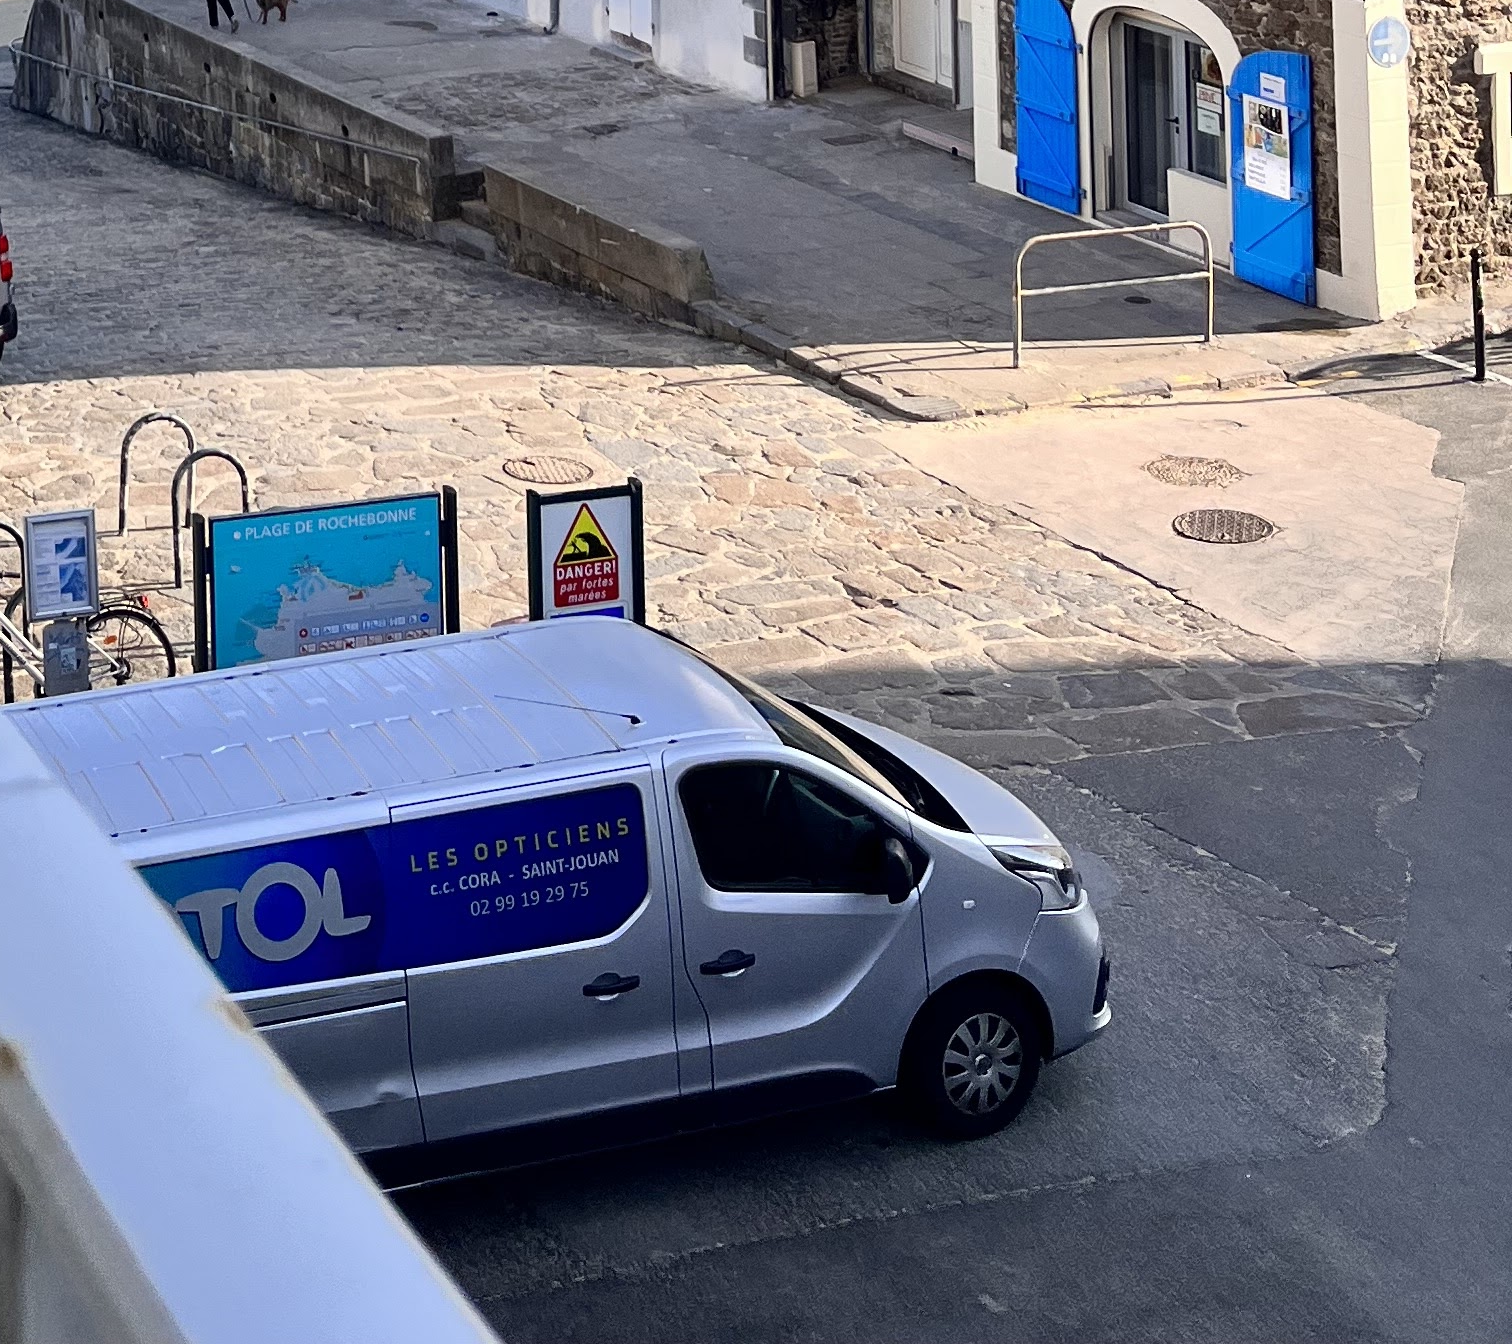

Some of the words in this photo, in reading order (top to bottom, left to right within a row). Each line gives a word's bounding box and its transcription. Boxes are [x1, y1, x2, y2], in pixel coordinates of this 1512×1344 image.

[245, 523, 290, 541] PLAGE
[295, 519, 313, 534] DE
[318, 507, 417, 531] ROCHEBONNE
[556, 560, 616, 581] DANGER!
[560, 582, 577, 595] par
[582, 576, 614, 590] fortes
[410, 848, 458, 872] LES
[474, 817, 630, 861] OPTICIENS
[459, 870, 501, 891] CORA
[522, 848, 620, 880] SAINT-JOUAN
[174, 861, 372, 962] TOL
[470, 899, 490, 916] 02
[495, 894, 515, 913] 99
[521, 890, 540, 907] 19
[546, 885, 565, 903] 29
[570, 880, 589, 899] 75
